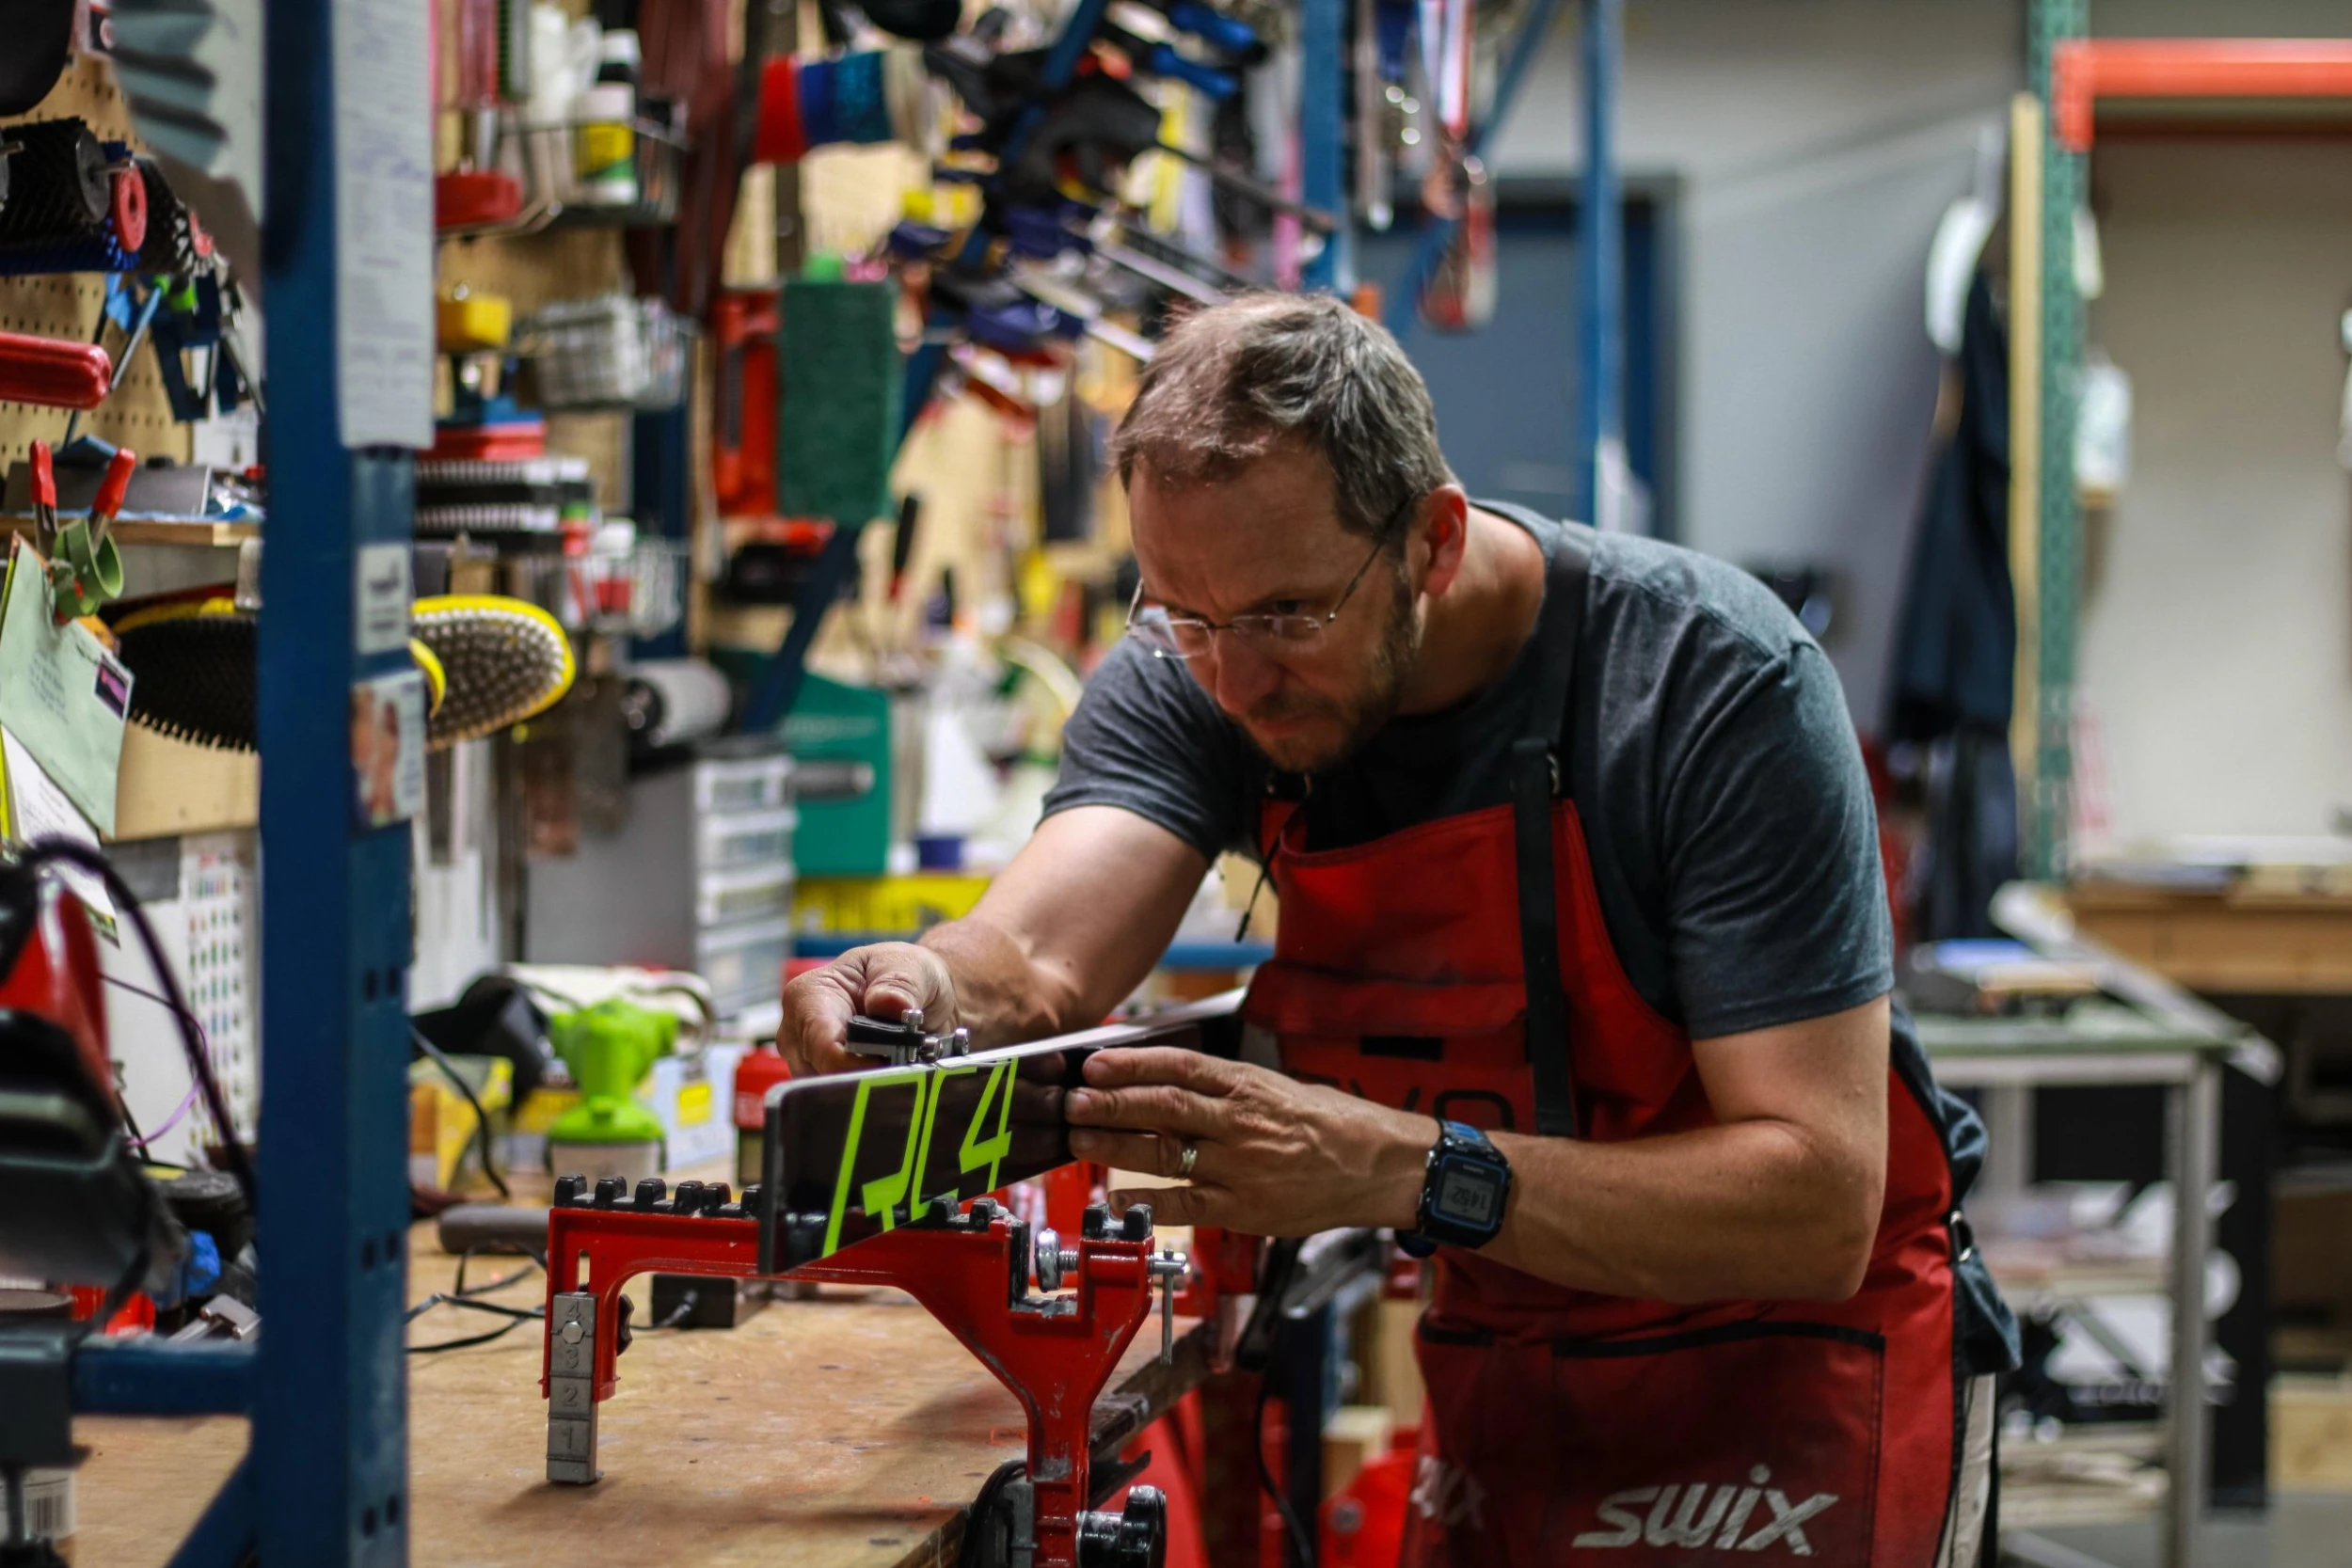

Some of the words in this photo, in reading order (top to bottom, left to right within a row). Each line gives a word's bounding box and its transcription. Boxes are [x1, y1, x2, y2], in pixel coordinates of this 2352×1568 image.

[565, 1348, 579, 1370] 3
[563, 1386, 577, 1407] 2
[563, 1426, 573, 1449] 1
